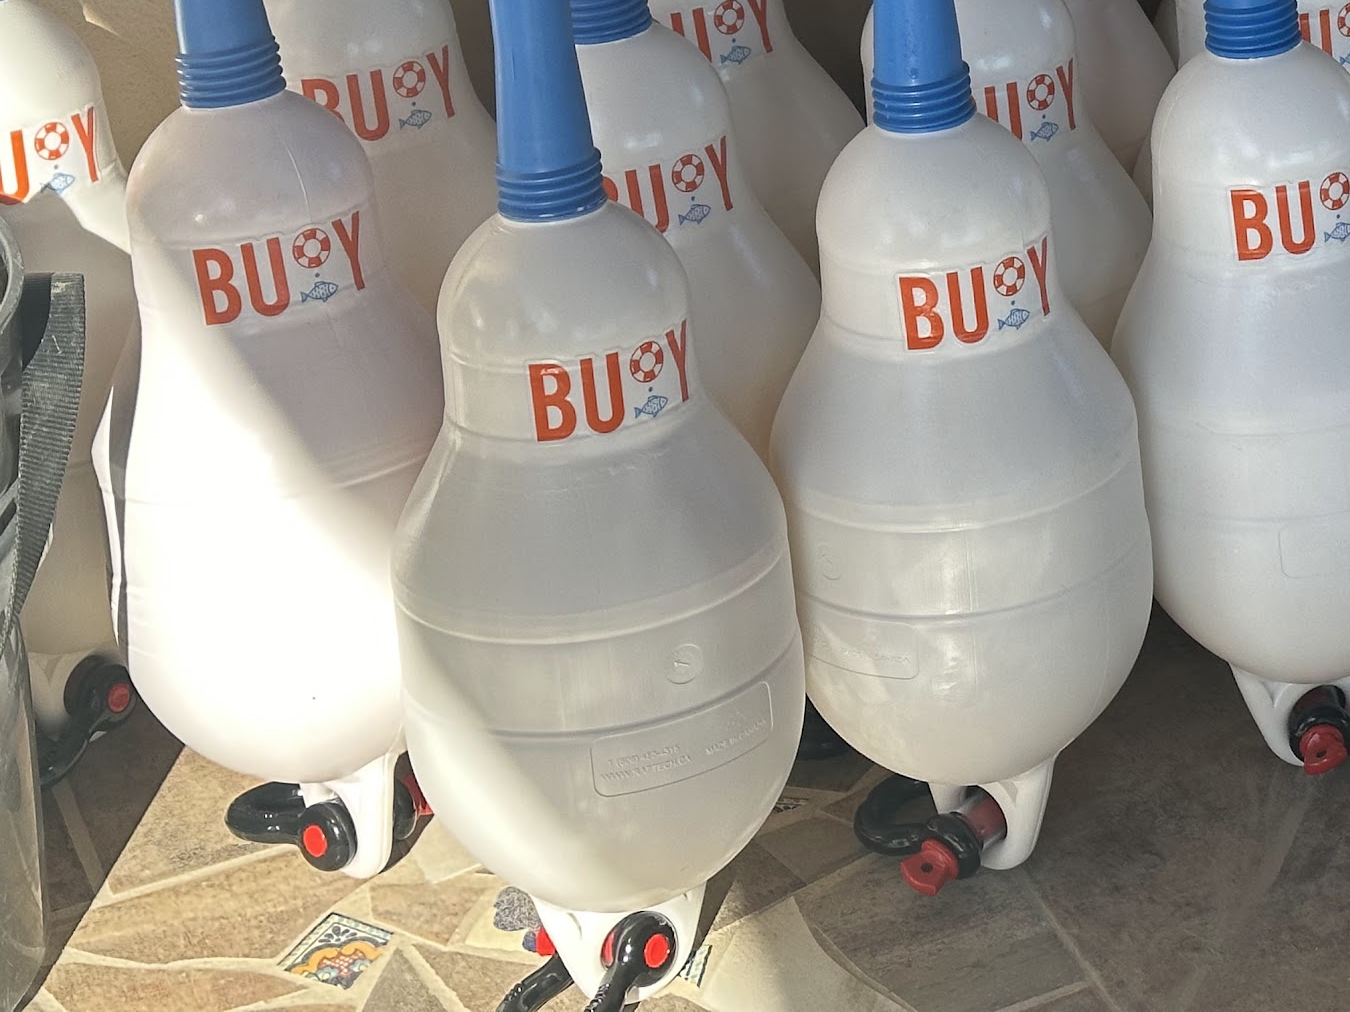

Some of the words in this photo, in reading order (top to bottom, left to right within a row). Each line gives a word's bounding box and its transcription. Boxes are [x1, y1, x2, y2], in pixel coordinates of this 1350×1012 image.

[0, 106, 99, 206] UOY
[603, 135, 734, 234] UOY
[192, 211, 366, 326] BUOY
[899, 236, 1050, 351] BUOY
[528, 319, 690, 443] BUOY
